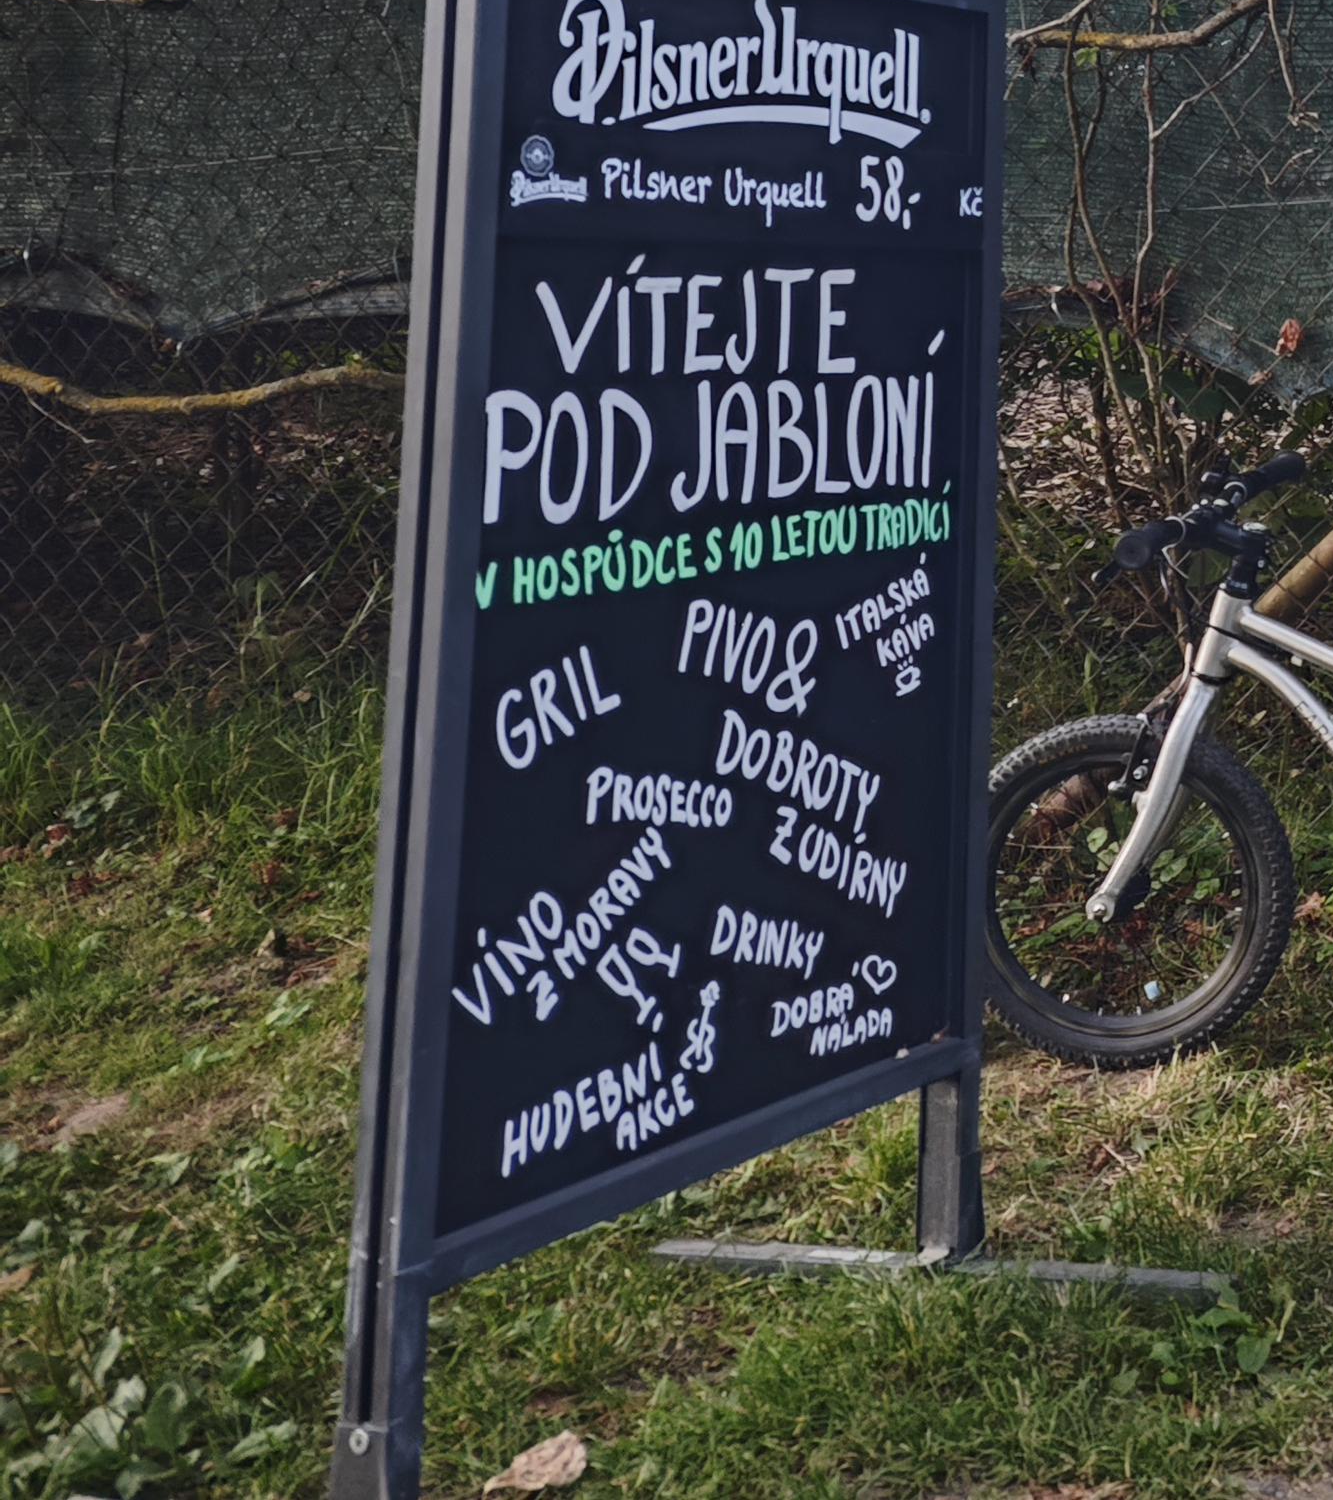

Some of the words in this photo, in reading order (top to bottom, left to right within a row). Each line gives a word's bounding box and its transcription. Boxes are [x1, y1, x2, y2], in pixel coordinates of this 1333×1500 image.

[601, 157, 712, 204] Pilsner
[724, 167, 826, 228] Urquell
[959, 187, 983, 217] Kč
[535, 253, 856, 375] VÍTEJTE
[482, 389, 652, 524] POD
[671, 329, 946, 512] JABLONÍ
[475, 561, 498, 610] V
[513, 529, 698, 604] HOSPŮDCE
[704, 527, 722, 573] S
[730, 521, 763, 572] 10
[771, 505, 857, 562] LETOU
[860, 480, 951, 551] TRADICÍ
[835, 552, 930, 650] ITALSKÁ
[876, 613, 935, 667] KÁVA
[497, 646, 621, 769] GRIL
[678, 599, 776, 694] PIVO
[766, 619, 818, 717] &
[586, 765, 732, 828] PROSECCO
[716, 709, 880, 834] DOBROTY
[553, 826, 671, 980] MORAVY
[798, 823, 907, 919] UDÍRNY
[452, 891, 563, 1025] VÍNO
[710, 905, 824, 980] DRINKY
[770, 960, 860, 1037] DOBRÁ
[810, 1007, 892, 1057] NÁLADA
[501, 1012, 662, 1178] HUDEBNÍ
[616, 1073, 694, 1150] AKCE
